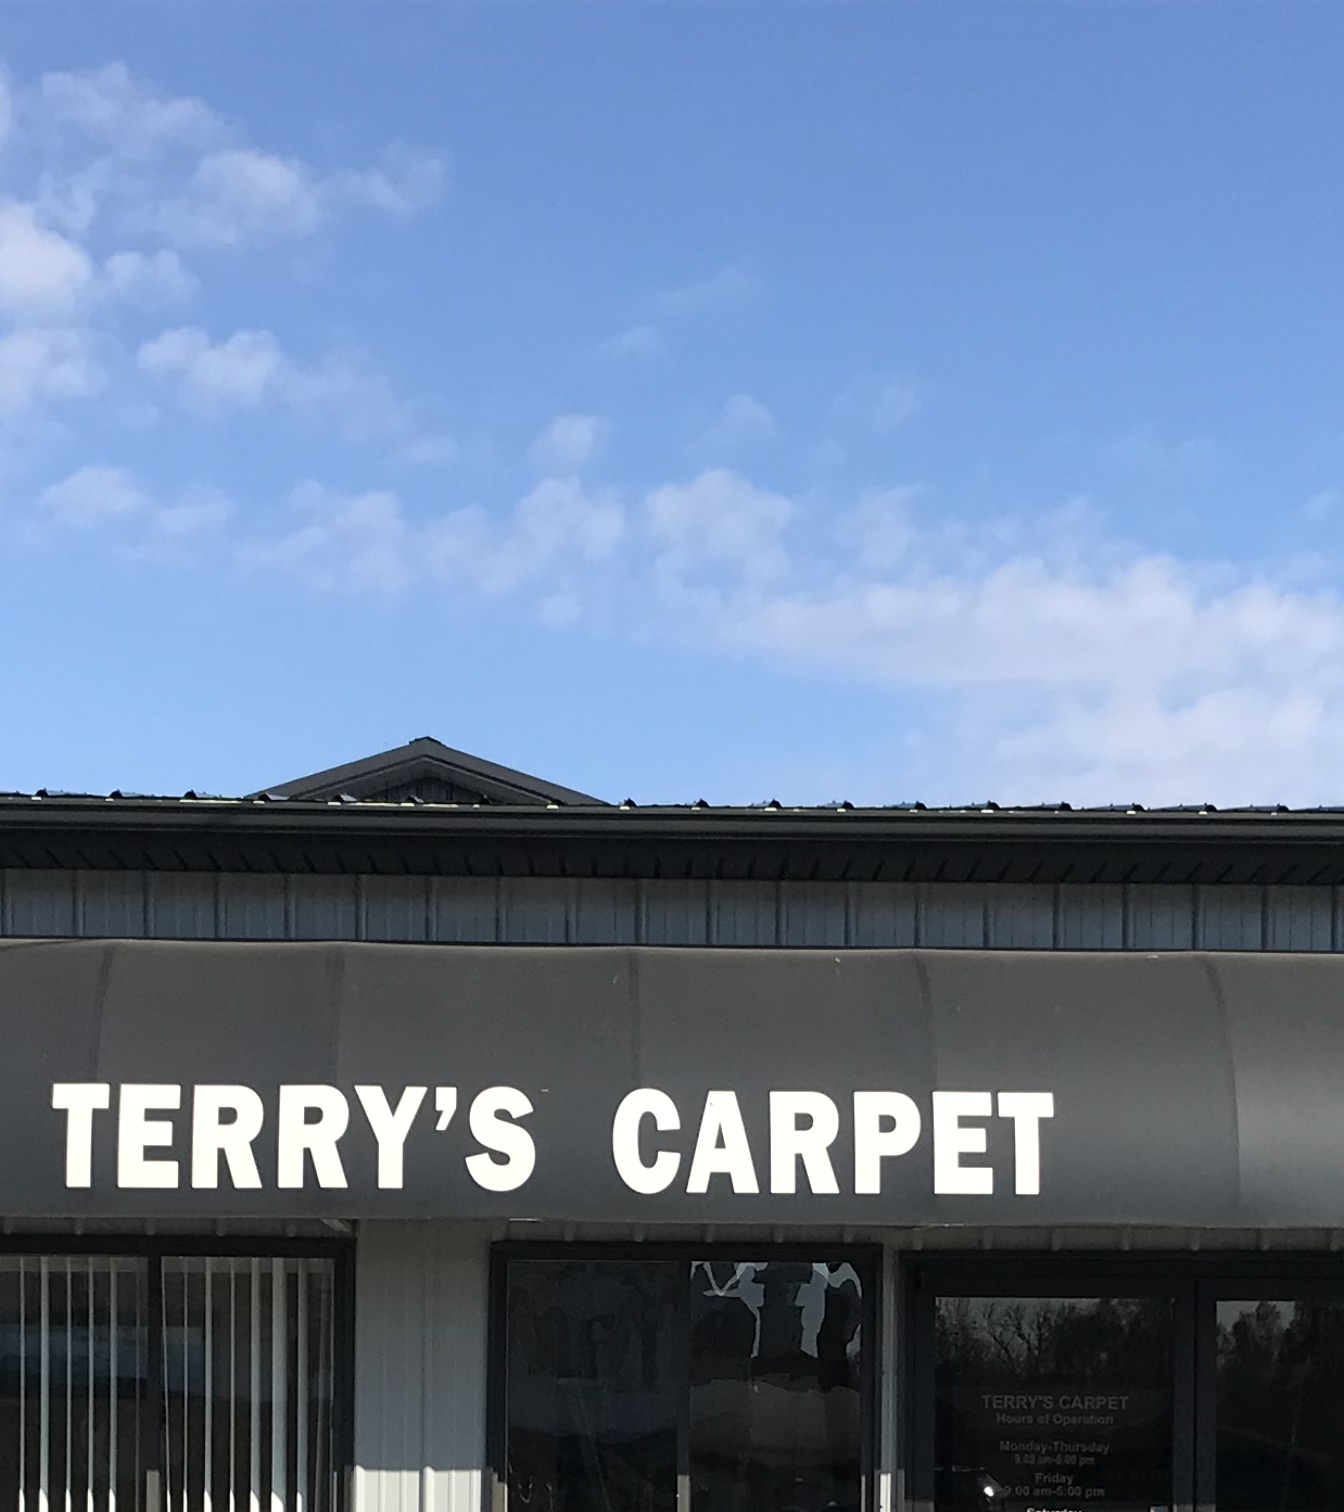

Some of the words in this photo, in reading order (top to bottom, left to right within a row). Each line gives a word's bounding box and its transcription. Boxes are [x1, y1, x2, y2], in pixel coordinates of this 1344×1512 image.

[52, 1082, 536, 1192] TERRY'S
[611, 1088, 1055, 1195] CARPET
[981, 1395, 1053, 1410] TERRY'S
[1059, 1395, 1129, 1410] CARPET
[996, 1413, 1033, 1424] Hours
[1037, 1413, 1049, 1424] of
[1053, 1413, 1114, 1426] Operation
[1035, 1473, 1074, 1486] Friday
[1085, 1488, 1105, 1499] pm
